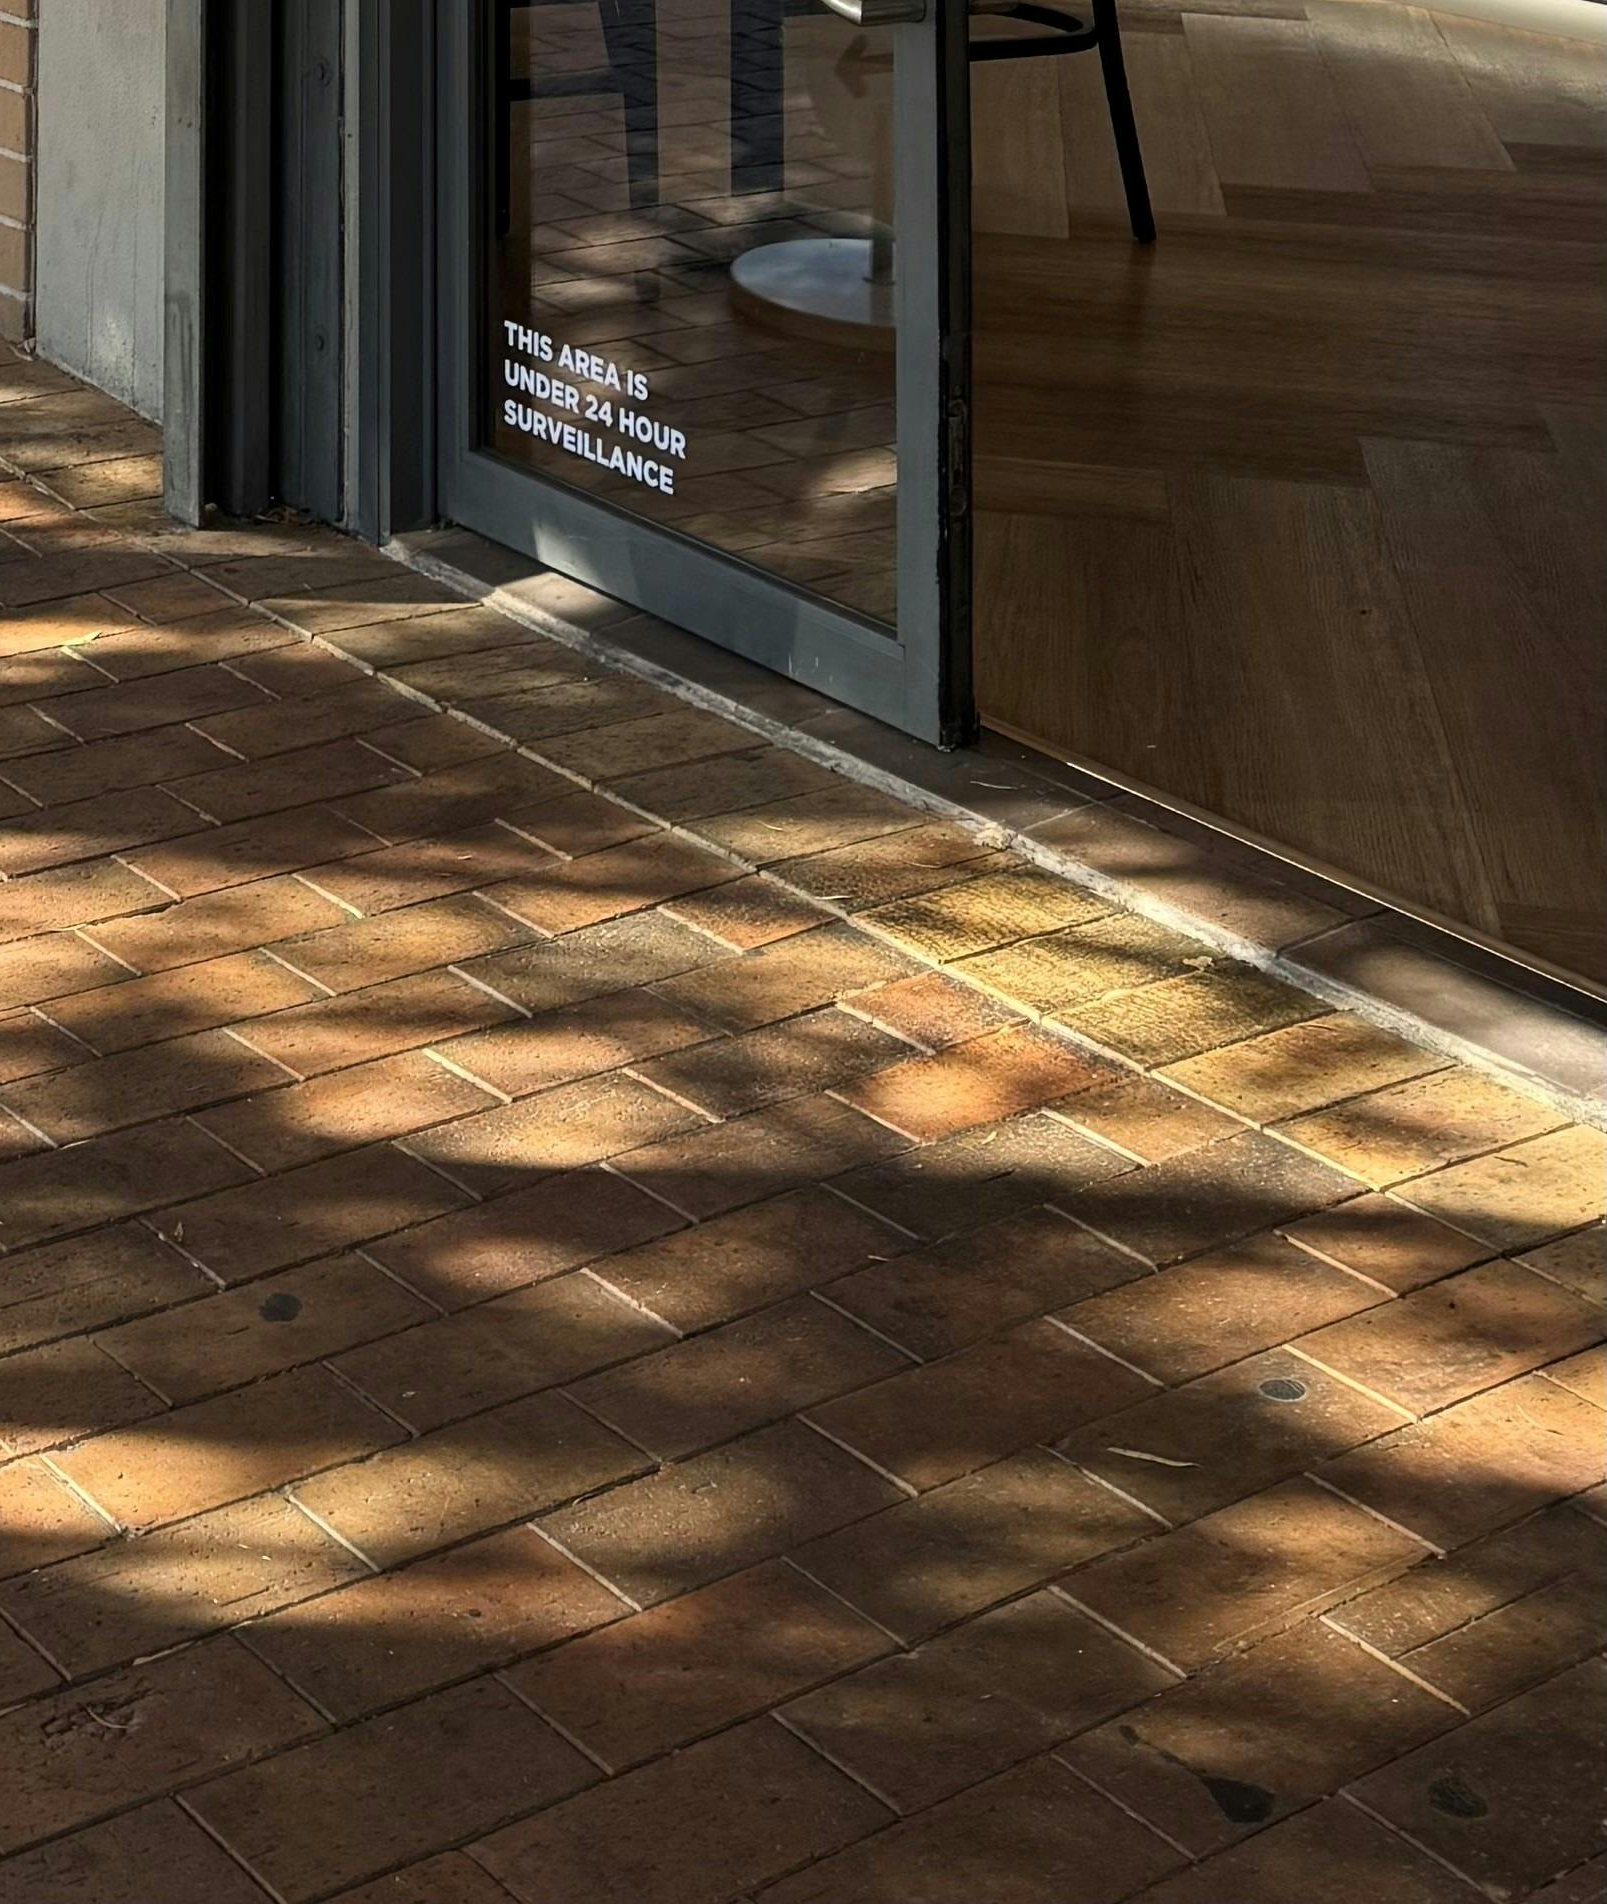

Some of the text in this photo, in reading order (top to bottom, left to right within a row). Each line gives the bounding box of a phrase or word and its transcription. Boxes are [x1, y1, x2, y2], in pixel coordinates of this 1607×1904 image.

[504, 320, 649, 401] THIS AREA IS
[503, 399, 674, 496] SURVEILLANCE
[504, 359, 686, 460] UNDER 24 HOUR
